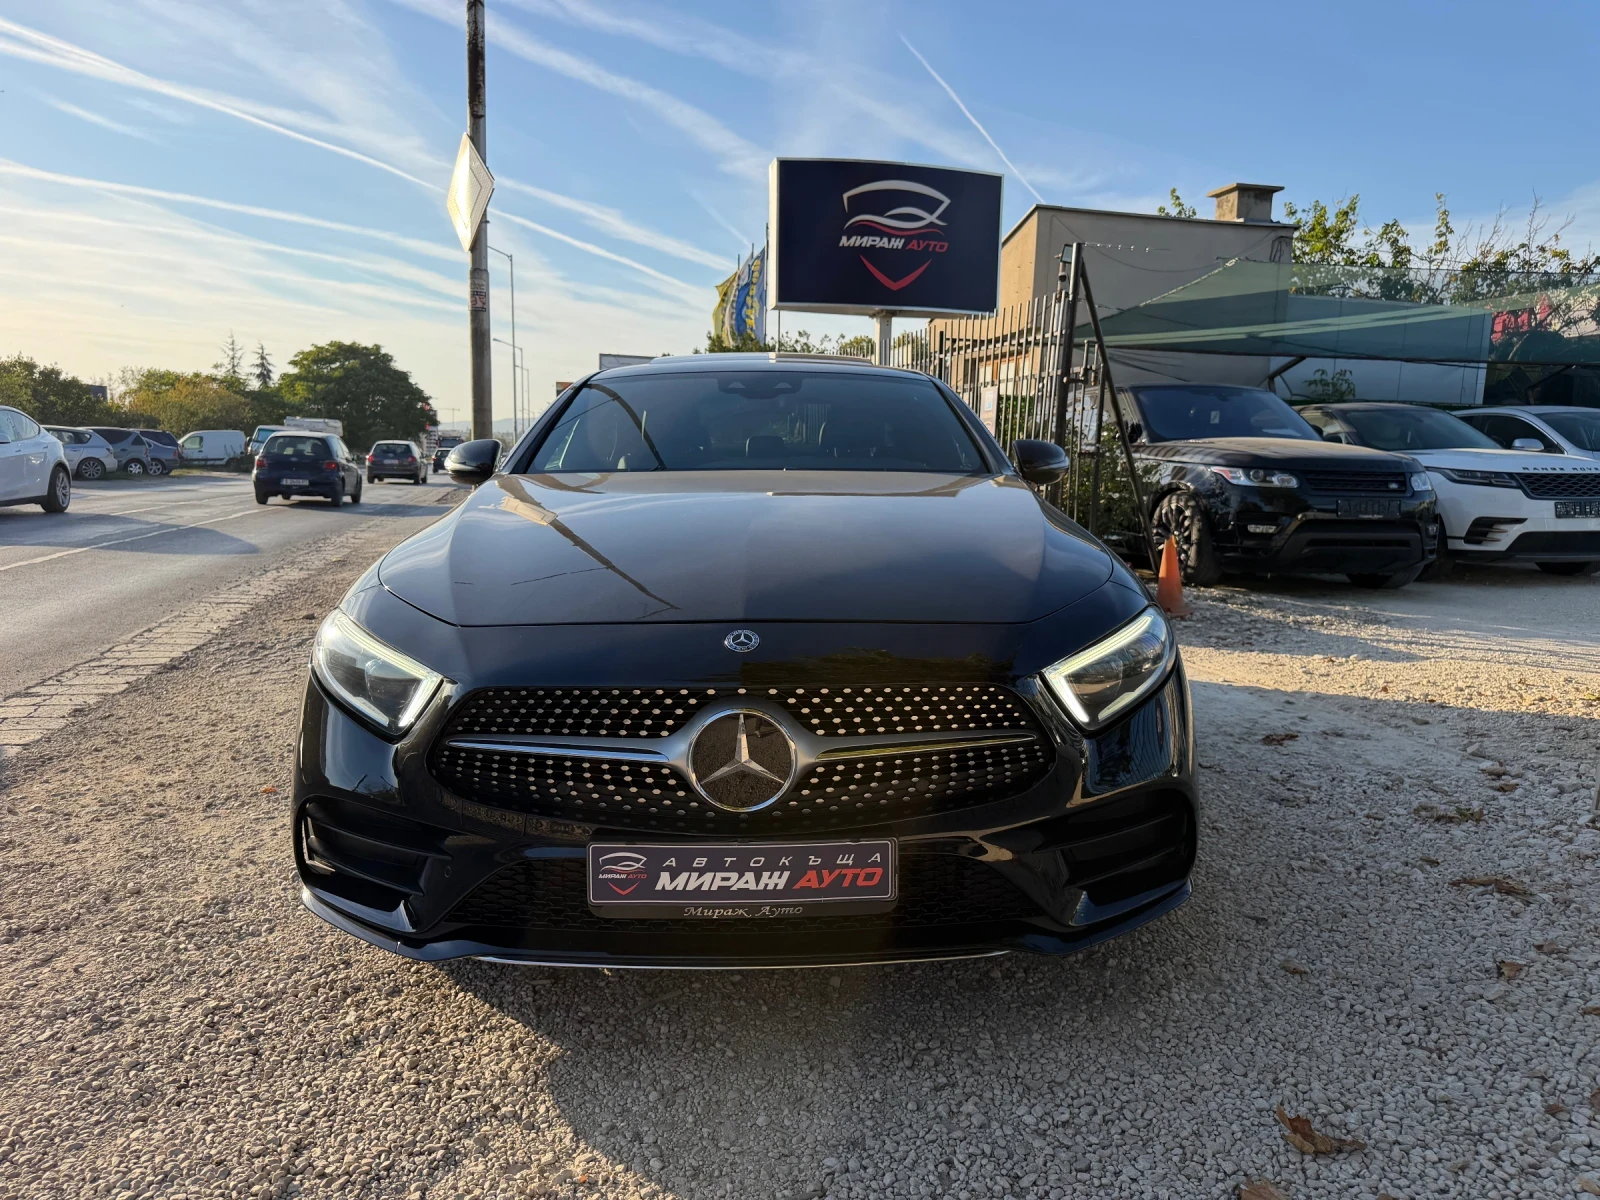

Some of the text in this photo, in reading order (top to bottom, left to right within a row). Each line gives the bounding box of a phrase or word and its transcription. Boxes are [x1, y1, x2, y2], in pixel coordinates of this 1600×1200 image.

[839, 235, 949, 253] МИРАЖ АУТО
[662, 852, 881, 868] АВТОКЪЩА
[655, 867, 883, 891] МИРАЖ АУТО
[683, 904, 804, 919] Мираж Ауто
